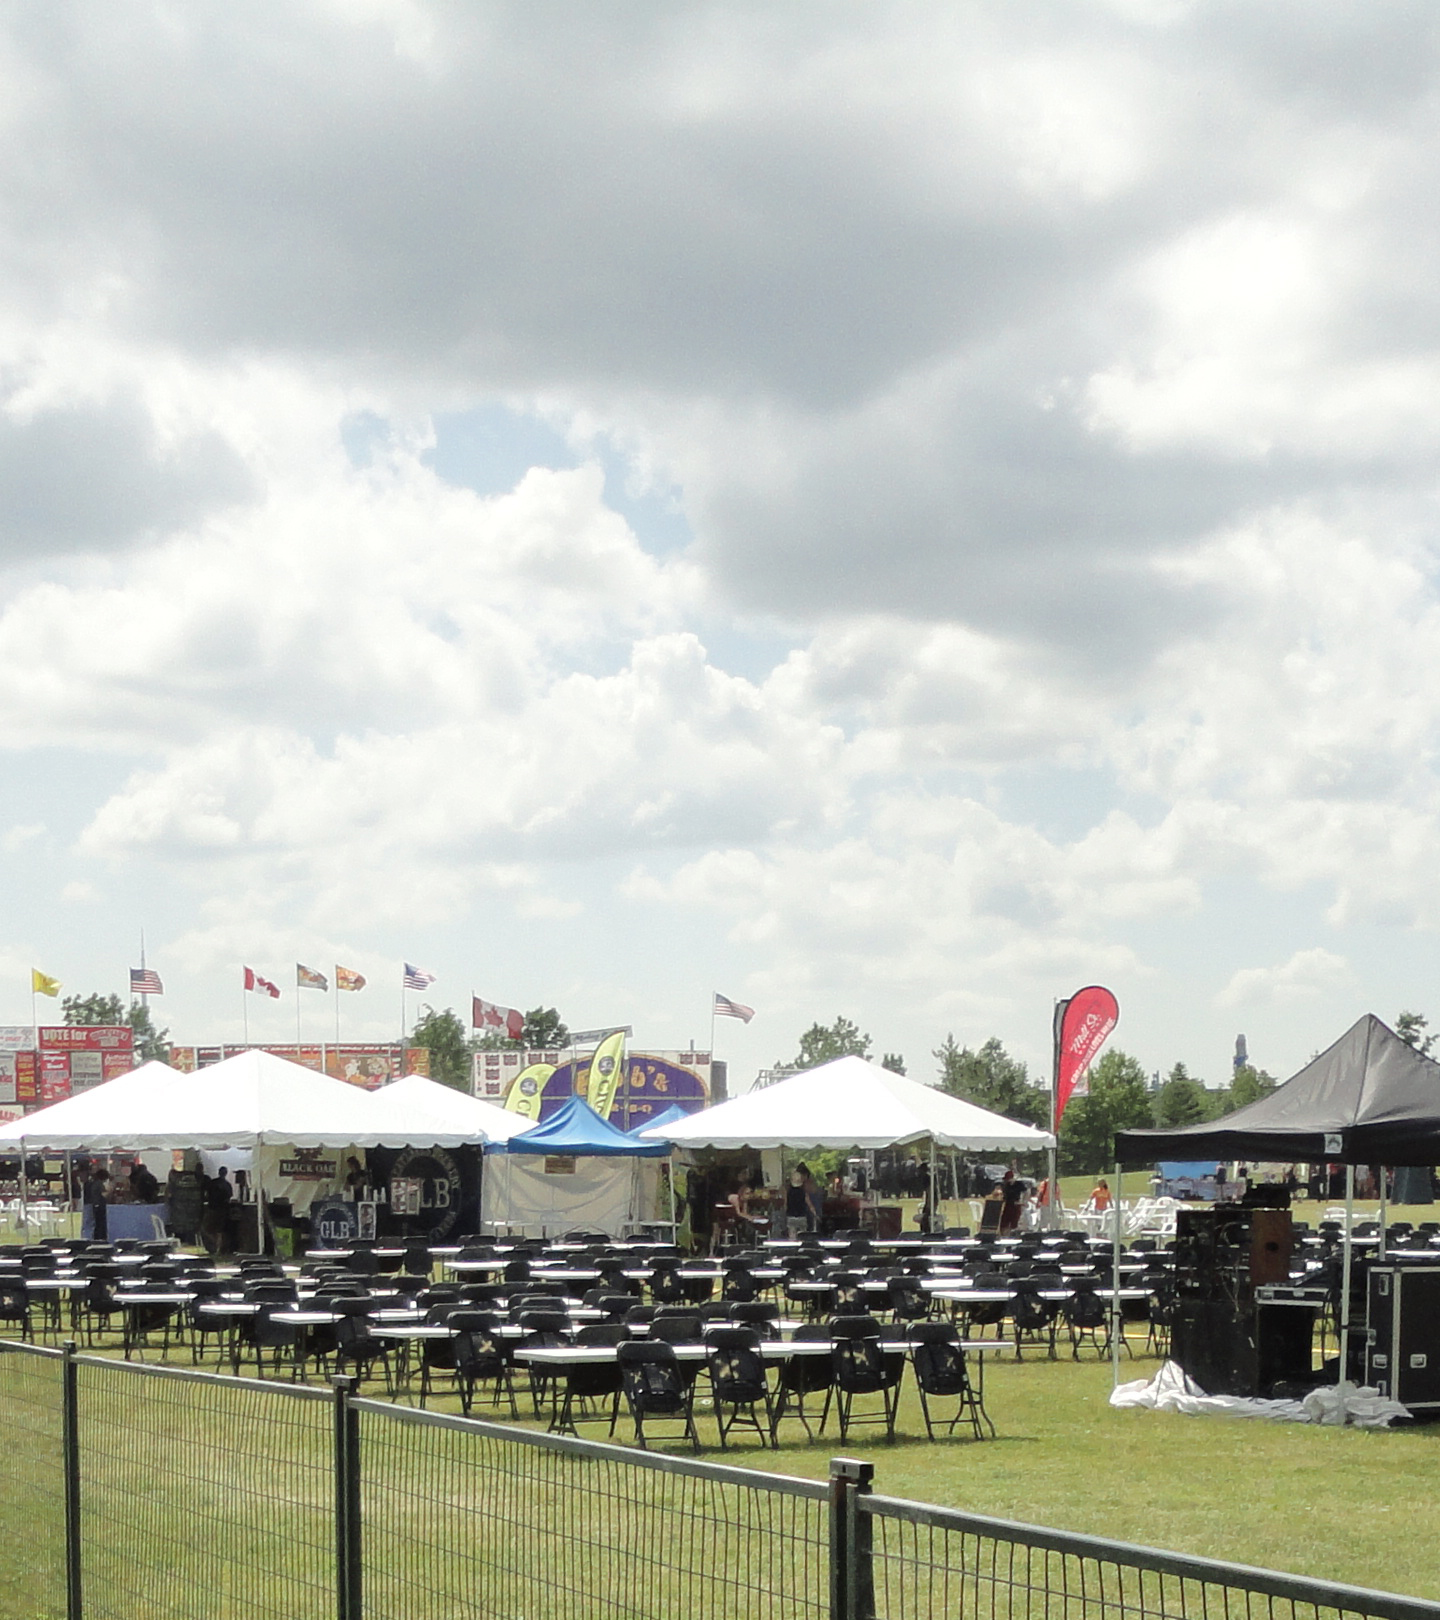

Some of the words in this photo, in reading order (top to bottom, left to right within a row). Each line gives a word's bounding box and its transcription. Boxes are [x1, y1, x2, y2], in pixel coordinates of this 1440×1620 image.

[42, 1029, 69, 1041] VOTE
[282, 1162, 312, 1173] BLACK
[420, 1178, 450, 1208] LB
[320, 1220, 350, 1240] GLB
